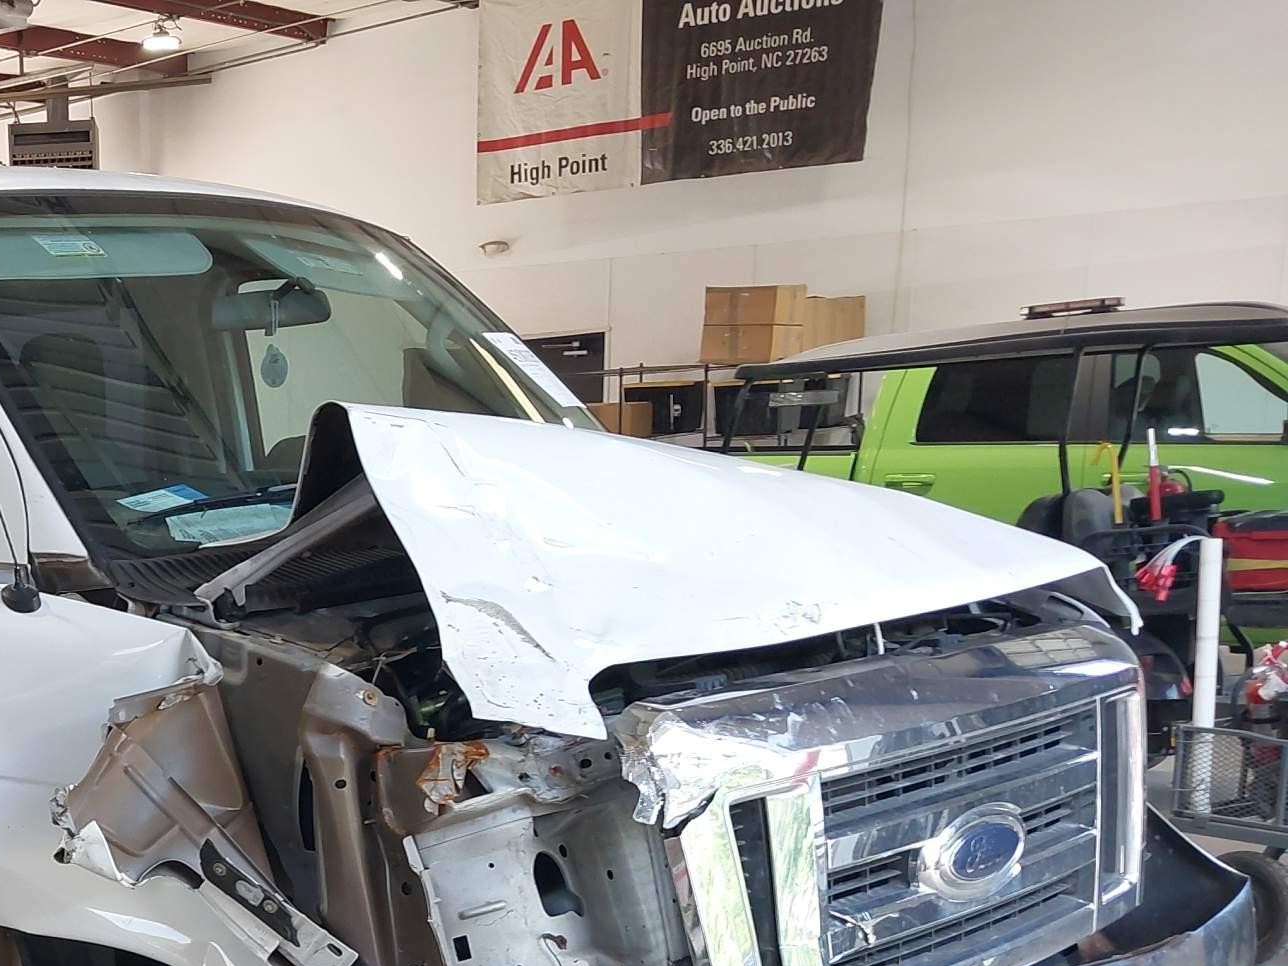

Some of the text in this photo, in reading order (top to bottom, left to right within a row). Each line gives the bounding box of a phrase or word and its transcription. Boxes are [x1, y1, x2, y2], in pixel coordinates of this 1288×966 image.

[678, 2, 731, 28] Auto
[701, 27, 814, 58] 6695 Auction Rd.
[686, 46, 829, 81] High Point, NC 27263
[691, 93, 816, 124] Open to the Public
[708, 131, 793, 155] 336.421.2013
[510, 153, 608, 185] High Point
